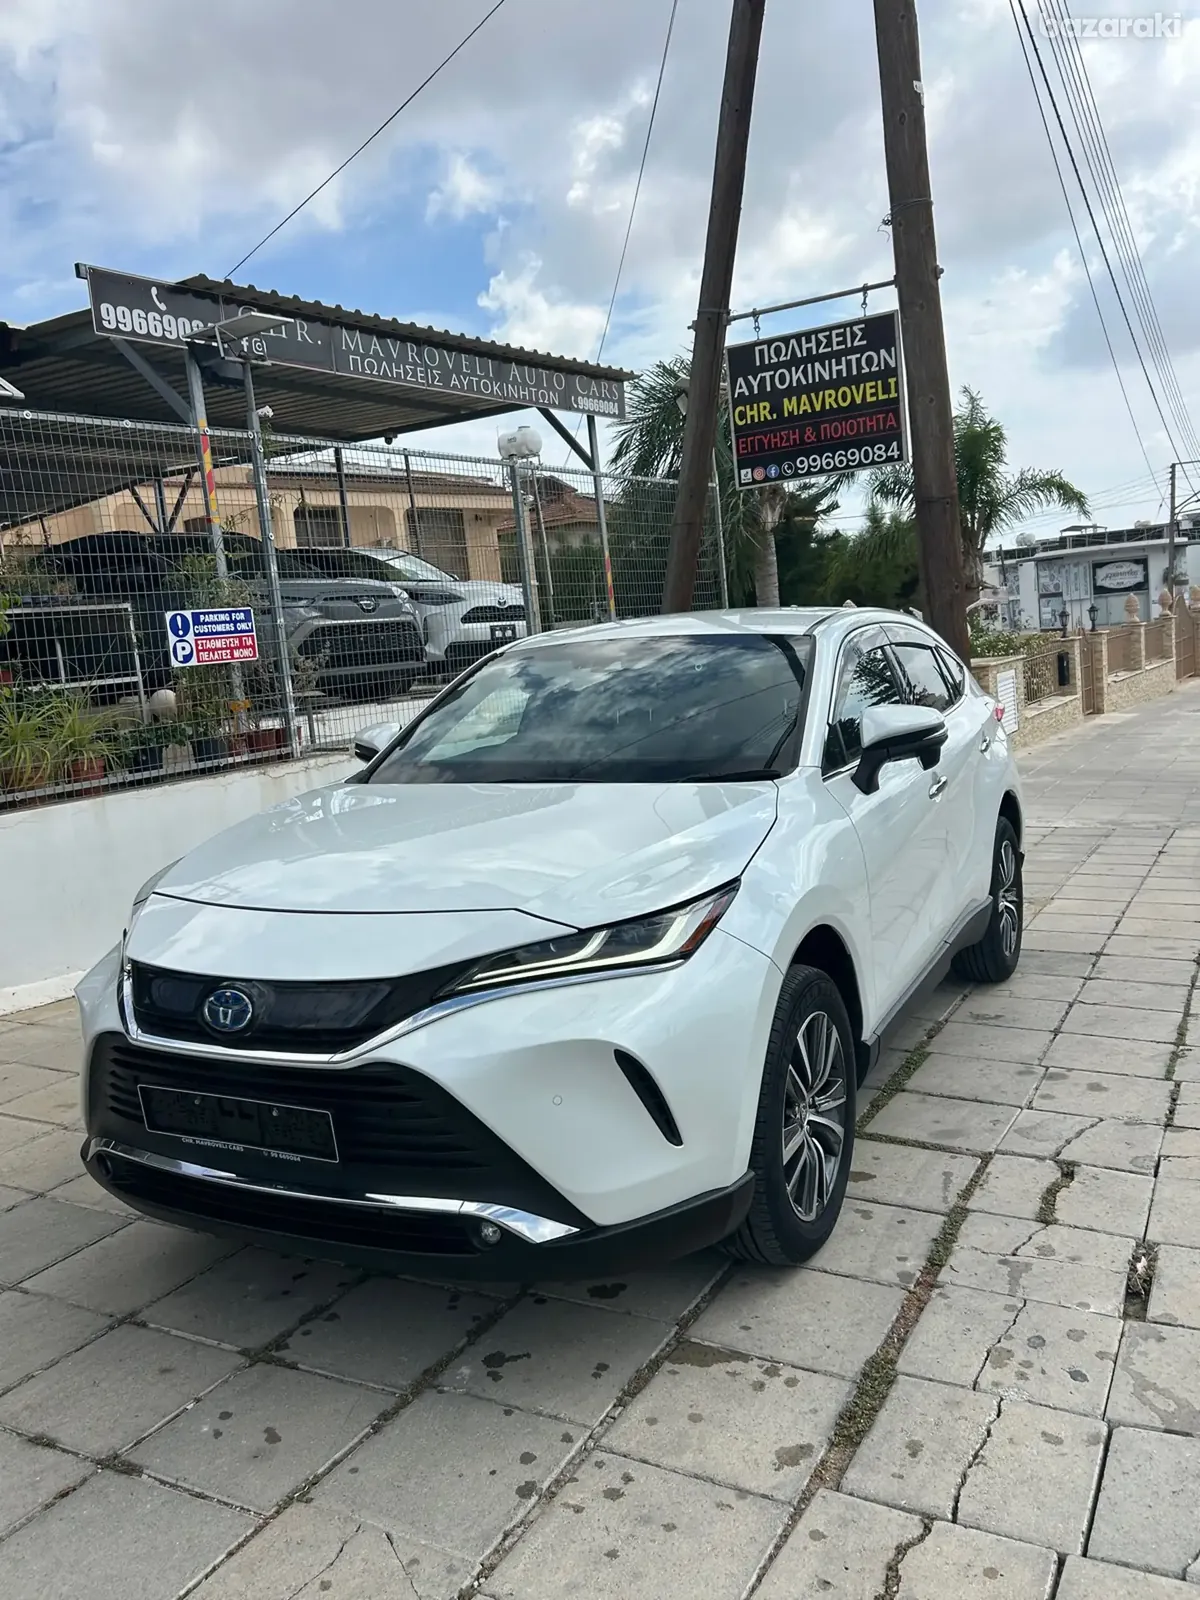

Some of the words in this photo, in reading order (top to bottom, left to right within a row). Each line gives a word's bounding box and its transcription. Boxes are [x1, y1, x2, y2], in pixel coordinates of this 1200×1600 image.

[754, 324, 867, 366] ΠΩΛΗΣΕΙΣ
[341, 327, 494, 378] MAVROVELI
[509, 362, 566, 391] AUTO
[576, 375, 619, 400] CARS
[734, 347, 896, 398] ΑΥΤΟΚΙΝΗΤΩΝ
[349, 355, 444, 386] ΠΩΛΗΣΕΙΣ
[450, 373, 559, 405] ΑΥΤΟΚΙΝΗΤΩΝ
[577, 396, 619, 415] 99669084
[734, 401, 777, 426] CHR.
[783, 377, 898, 417] MAVROVELI
[738, 429, 800, 454] ΕΓΓΥΗΣΗ
[804, 427, 817, 442] &
[821, 412, 897, 440] ΠΟΙΟΤΗΤΑ
[796, 441, 900, 474] 99669084
[194, 623, 235, 633] CUSTOMERS
[236, 622, 252, 630] ONLY
[200, 612, 230, 623] PARKING
[232, 612, 245, 621] FOR
[176, 641, 191, 661] P
[197, 638, 239, 650] ΣΤΑΘΜΕΥΣΗ
[242, 637, 253, 646] ΓΙΑ
[199, 650, 231, 661] ΠΕΛΑΤΕΣ
[233, 648, 253, 659] ΜΟΝΟ
[228, 1143, 244, 1152] CARS
